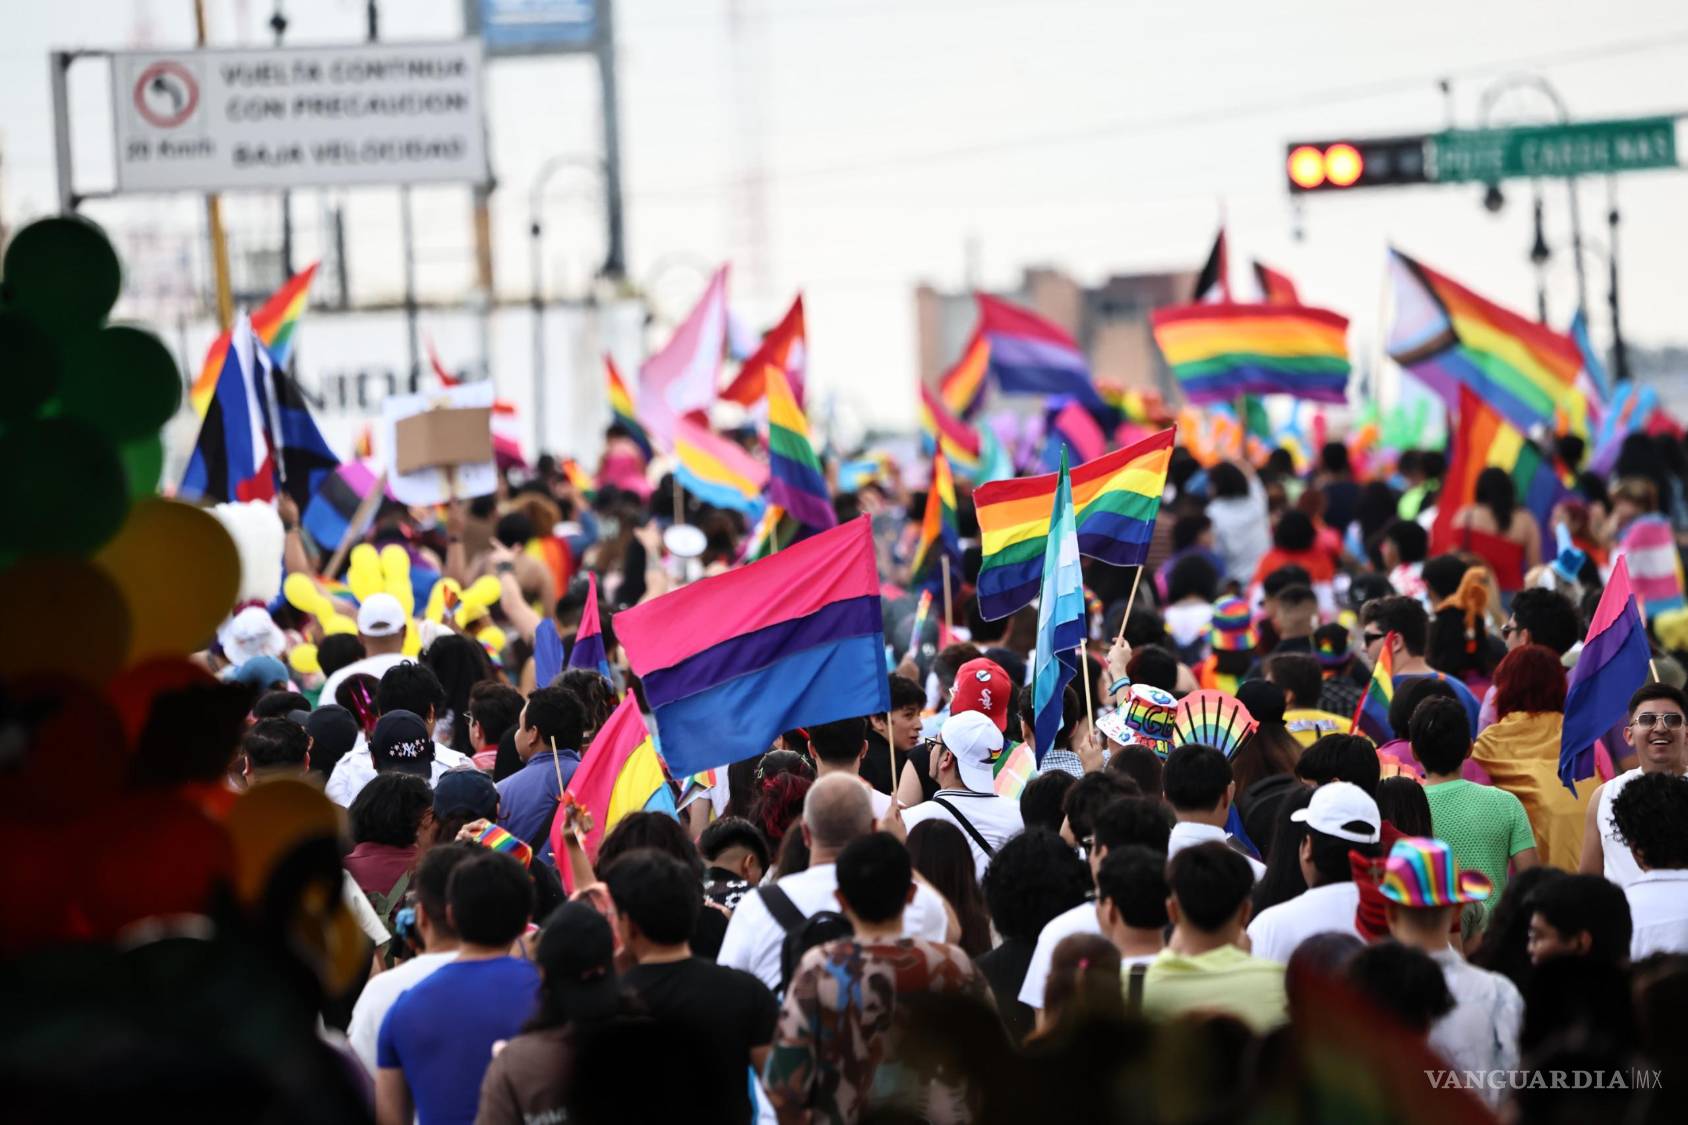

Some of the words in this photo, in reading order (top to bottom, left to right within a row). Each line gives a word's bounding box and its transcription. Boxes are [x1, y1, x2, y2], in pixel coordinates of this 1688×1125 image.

[219, 61, 321, 87] VUELTA
[329, 57, 466, 84] CONTINUA
[225, 95, 286, 121] CON
[233, 142, 302, 168] BAJA
[312, 136, 465, 165] VELOCIDAD
